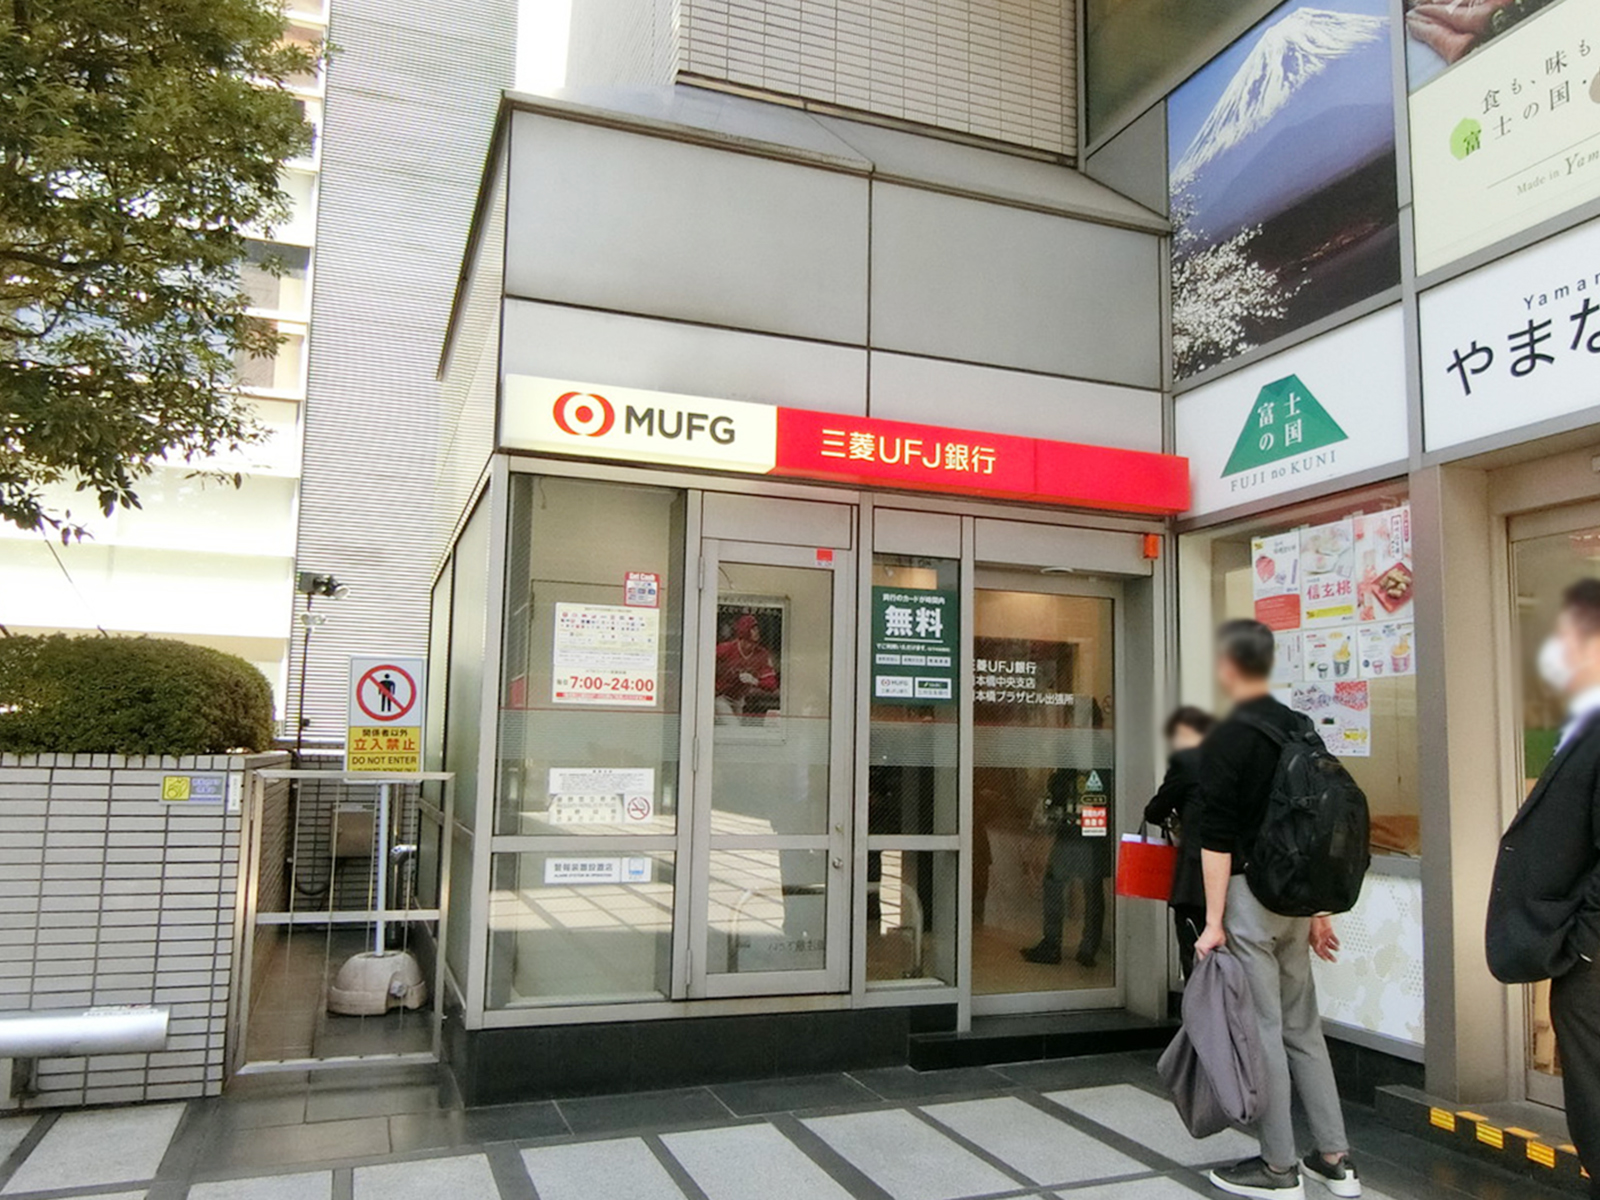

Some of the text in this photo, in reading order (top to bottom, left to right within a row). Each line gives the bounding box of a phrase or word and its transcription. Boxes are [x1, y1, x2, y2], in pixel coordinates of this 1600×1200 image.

[1516, 173, 1546, 195] Made
[1549, 168, 1560, 180] in
[1447, 298, 1600, 396] やまな
[624, 405, 736, 446] MUFG
[821, 428, 996, 476] 三菱UFJ銀行
[1230, 450, 1336, 492] FUJI no KUNI
[1306, 580, 1352, 601] 信玄桃
[885, 605, 944, 638] 無料
[973, 659, 1036, 674] 菱UFJ銀行
[973, 676, 1036, 689] 本橋中央支店
[973, 690, 1074, 705] 本橋プラザビル出張所
[362, 729, 408, 737] 関係者以外
[353, 738, 416, 751] 立入禁止
[351, 756, 417, 765] DO NOT ENTER
